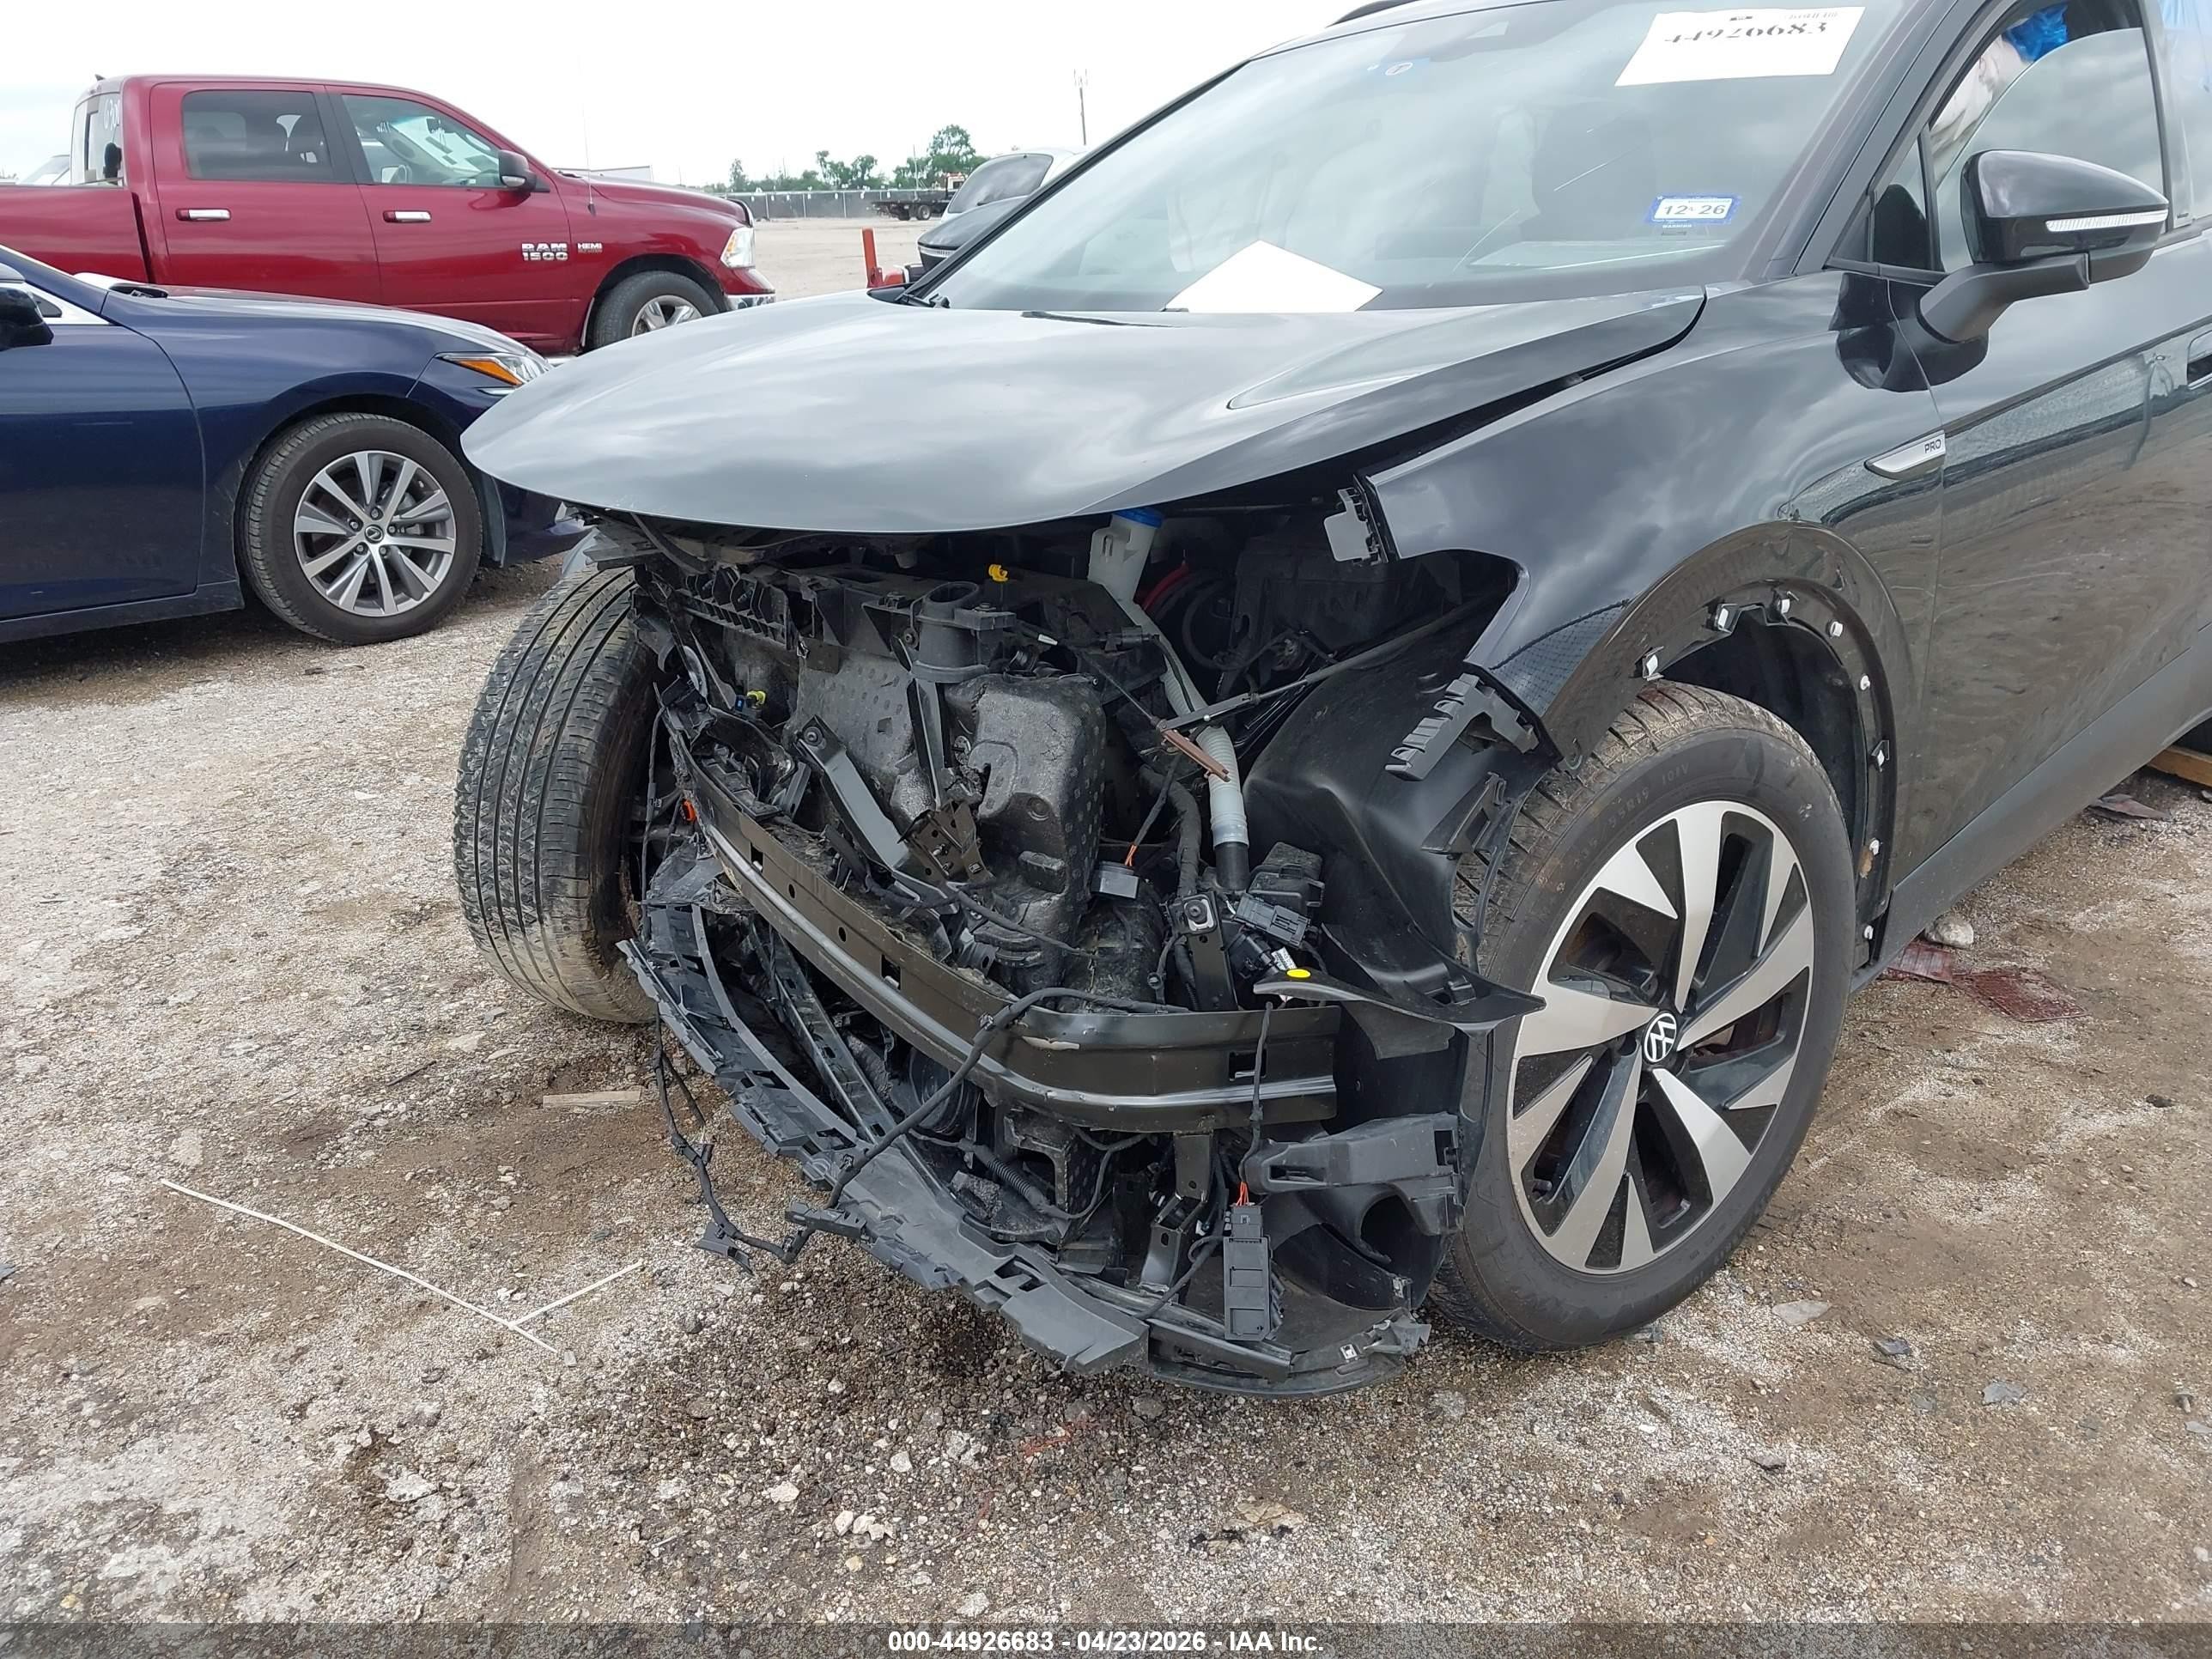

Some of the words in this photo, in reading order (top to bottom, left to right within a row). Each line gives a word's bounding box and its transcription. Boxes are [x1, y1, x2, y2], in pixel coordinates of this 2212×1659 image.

[1665, 205, 1688, 215] 12
[1698, 205, 1726, 215] 26
[521, 243, 567, 252] RAM
[522, 252, 568, 261] 1500
[1924, 439, 1942, 454] PRO
